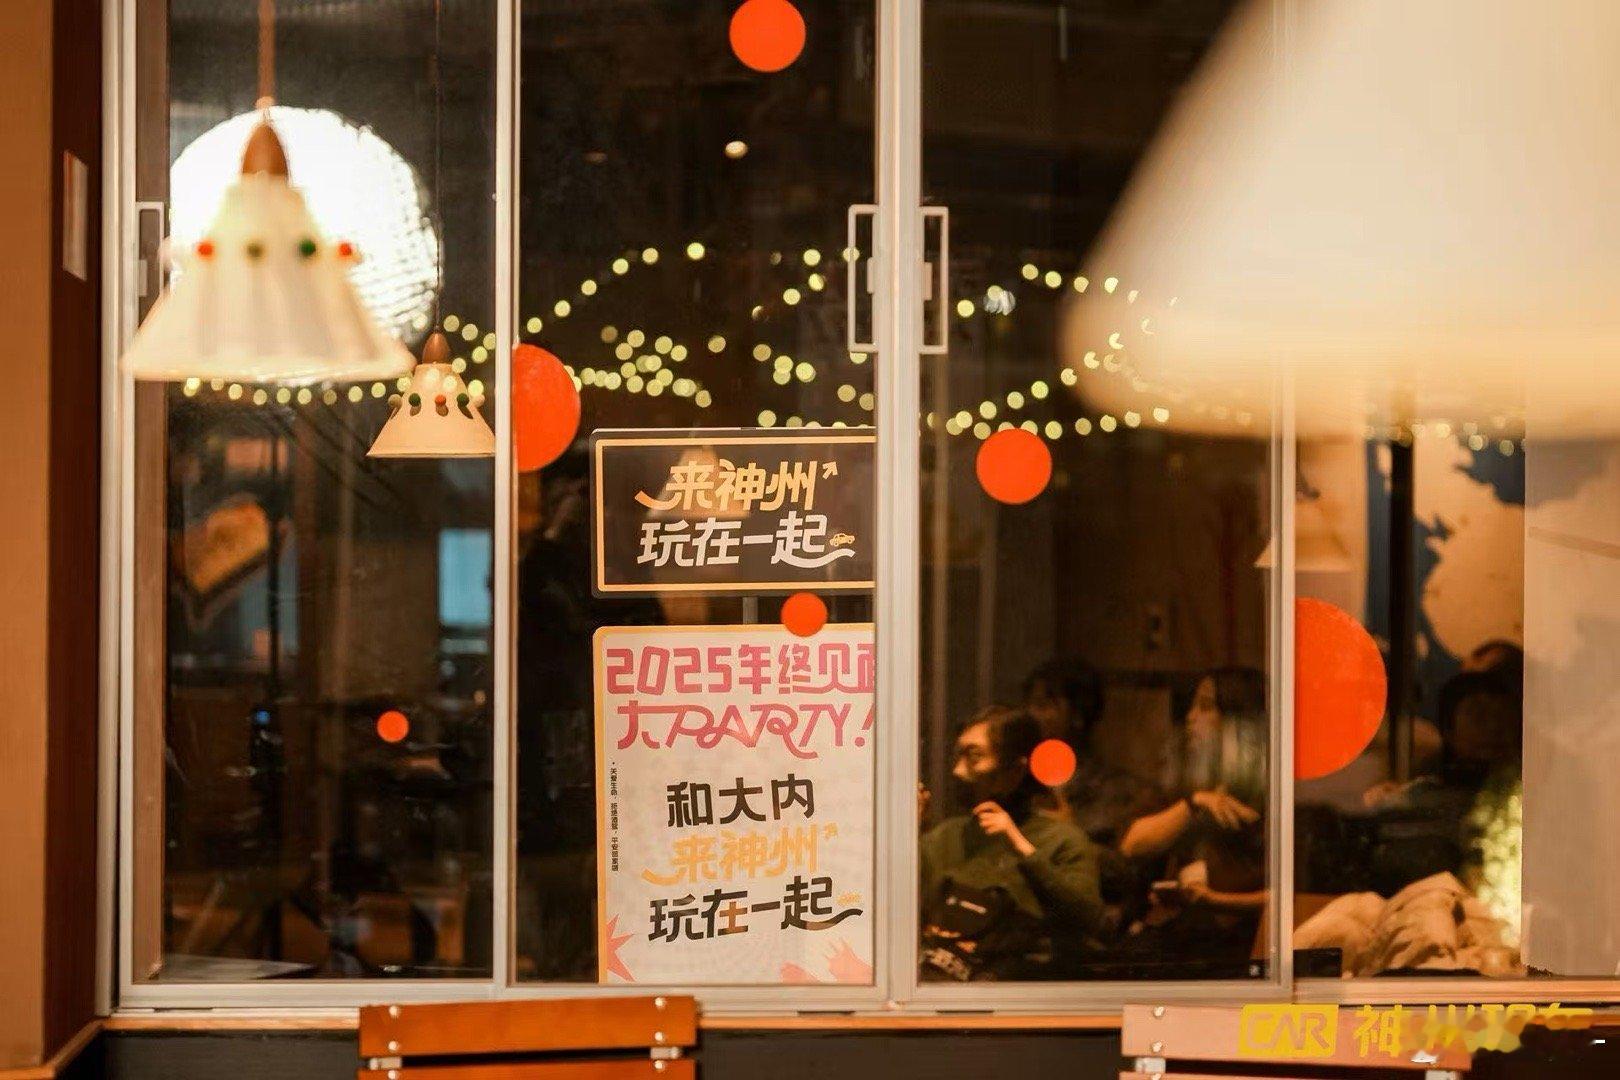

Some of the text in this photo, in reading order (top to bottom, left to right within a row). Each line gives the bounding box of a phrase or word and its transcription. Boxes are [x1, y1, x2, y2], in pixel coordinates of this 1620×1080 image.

[634, 458, 817, 511] 来神州
[637, 511, 855, 568] 玩在一起
[666, 773, 815, 828] 和大内
[641, 823, 818, 886] 来神州
[648, 875, 863, 942] 玩在一起
